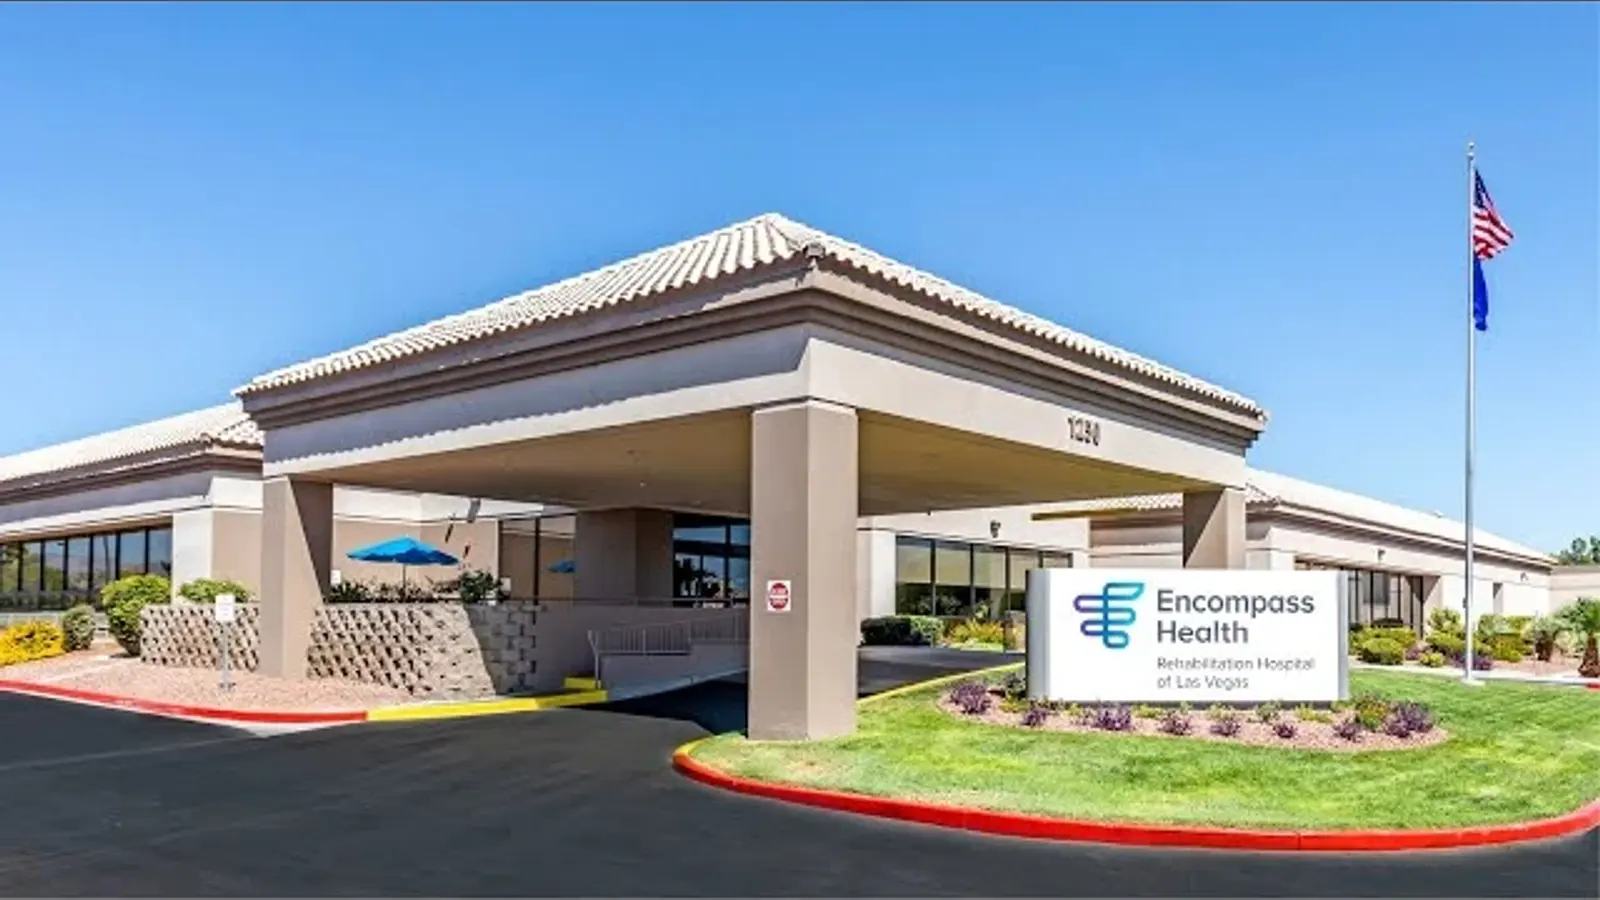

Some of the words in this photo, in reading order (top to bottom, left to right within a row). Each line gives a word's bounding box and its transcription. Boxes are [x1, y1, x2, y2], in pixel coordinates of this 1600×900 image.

[1157, 589, 1315, 618] Encompass
[1157, 620, 1249, 644] Health
[1157, 656, 1254, 671] Rehabilitation
[1257, 656, 1316, 673] Hospital
[1157, 676, 1172, 689] of
[1176, 676, 1201, 689] Las
[1204, 676, 1249, 691] Vegas
